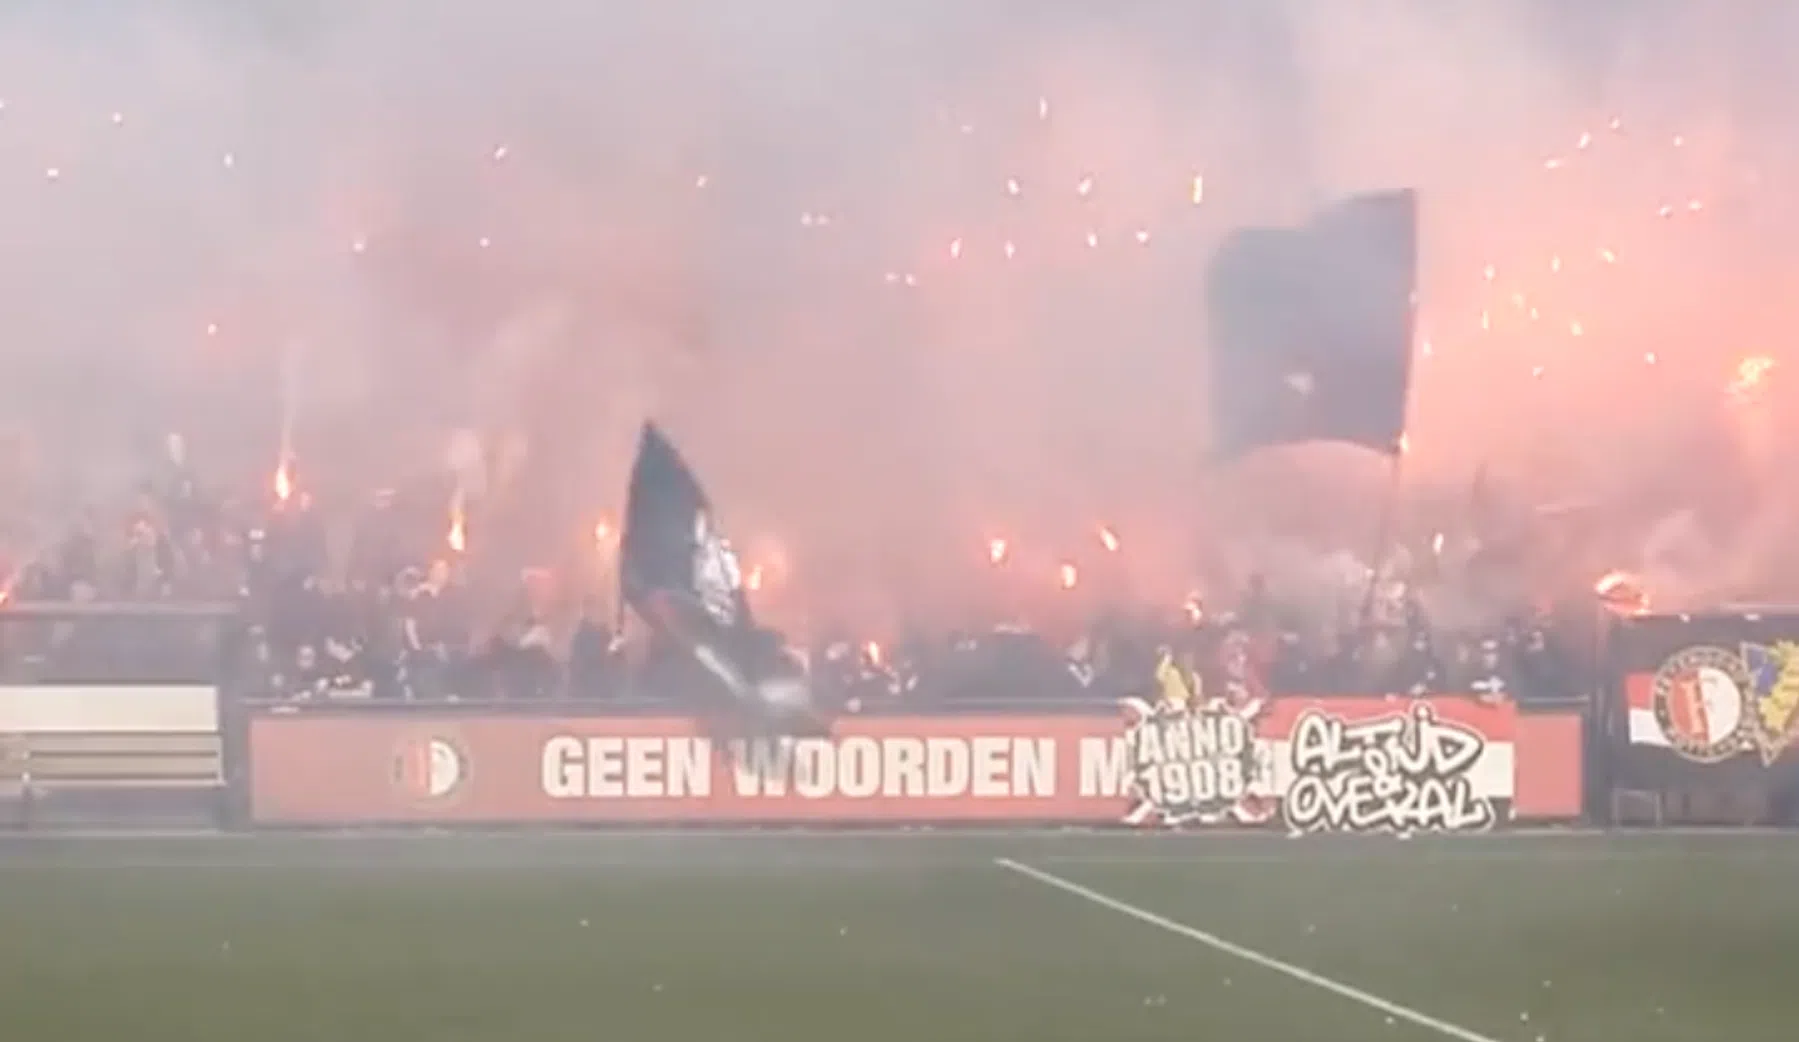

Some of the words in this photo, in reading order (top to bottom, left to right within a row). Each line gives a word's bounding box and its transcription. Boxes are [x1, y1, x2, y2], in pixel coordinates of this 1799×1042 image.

[1138, 715, 1245, 763] ANNO
[542, 735, 712, 798] GEEN
[727, 736, 1056, 799] WOORDEN
[1079, 737, 1132, 797] M
[1140, 757, 1245, 805] 1908
[1289, 770, 1486, 828] OVERAL
